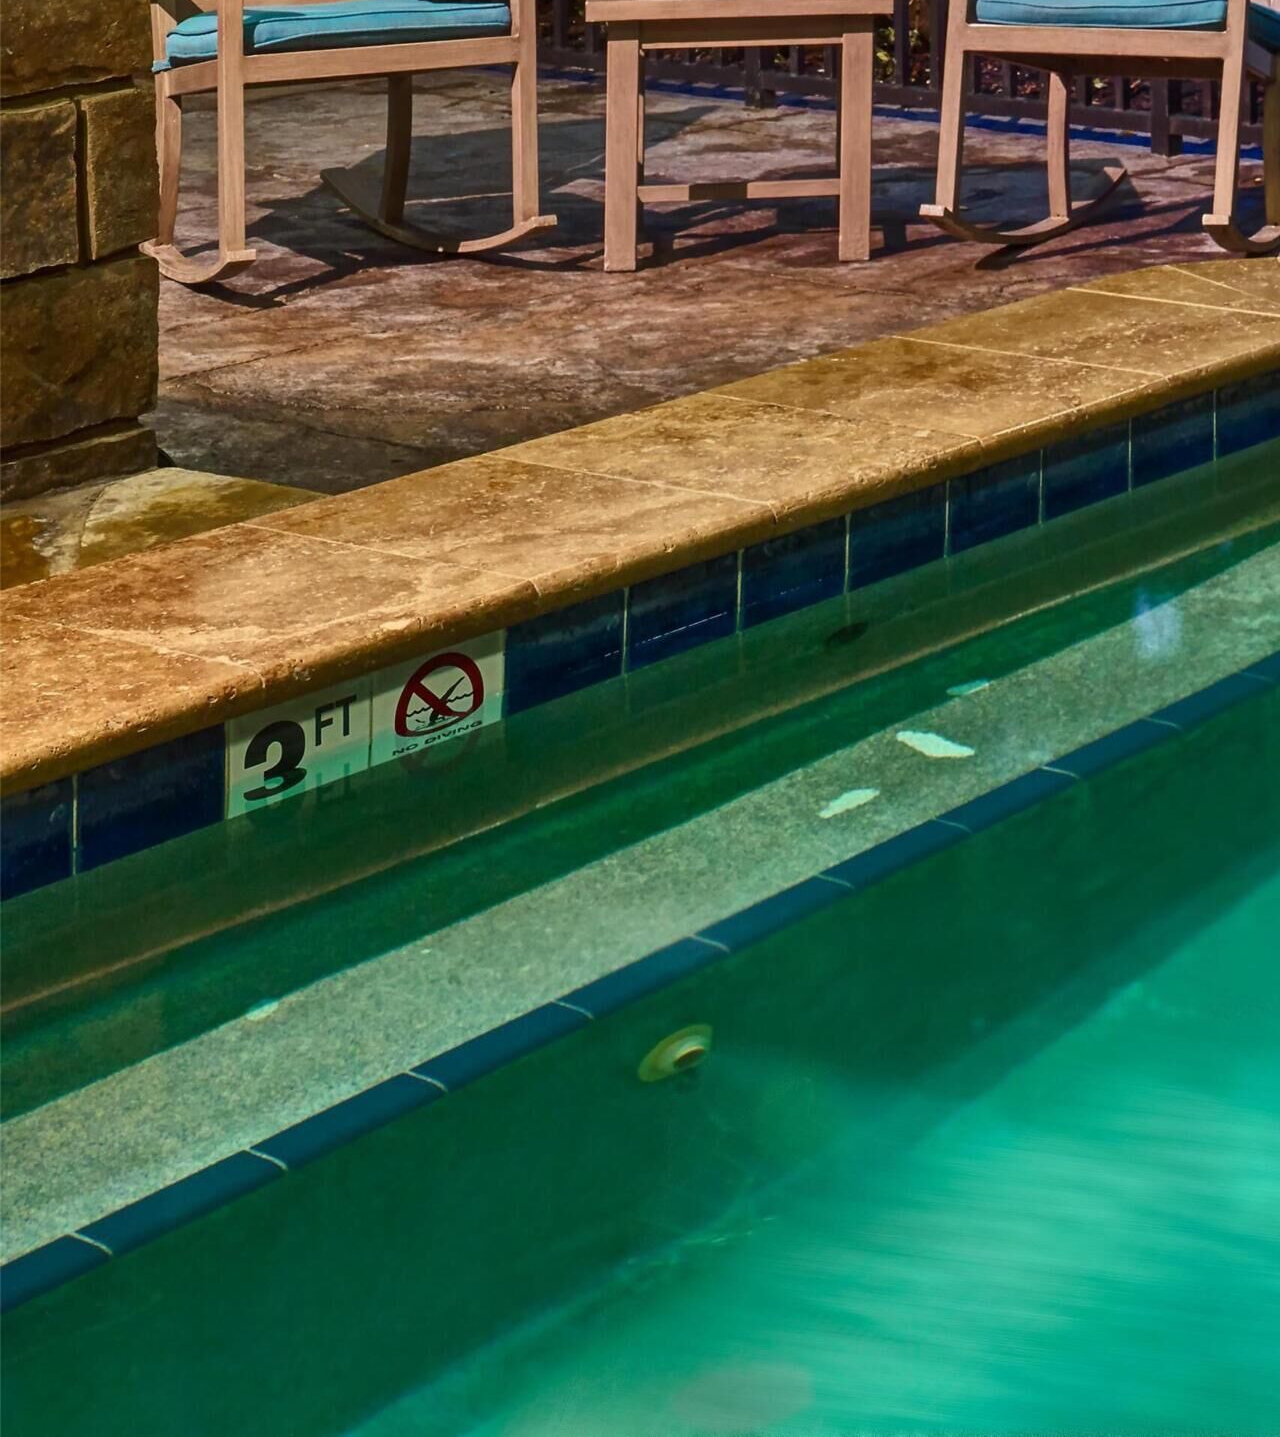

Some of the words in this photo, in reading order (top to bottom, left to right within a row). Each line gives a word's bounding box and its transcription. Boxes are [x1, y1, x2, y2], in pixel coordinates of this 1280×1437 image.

[243, 720, 307, 801] 3
[315, 695, 356, 746] FT
[392, 743, 418, 756] NO
[424, 720, 482, 744] DIVING
